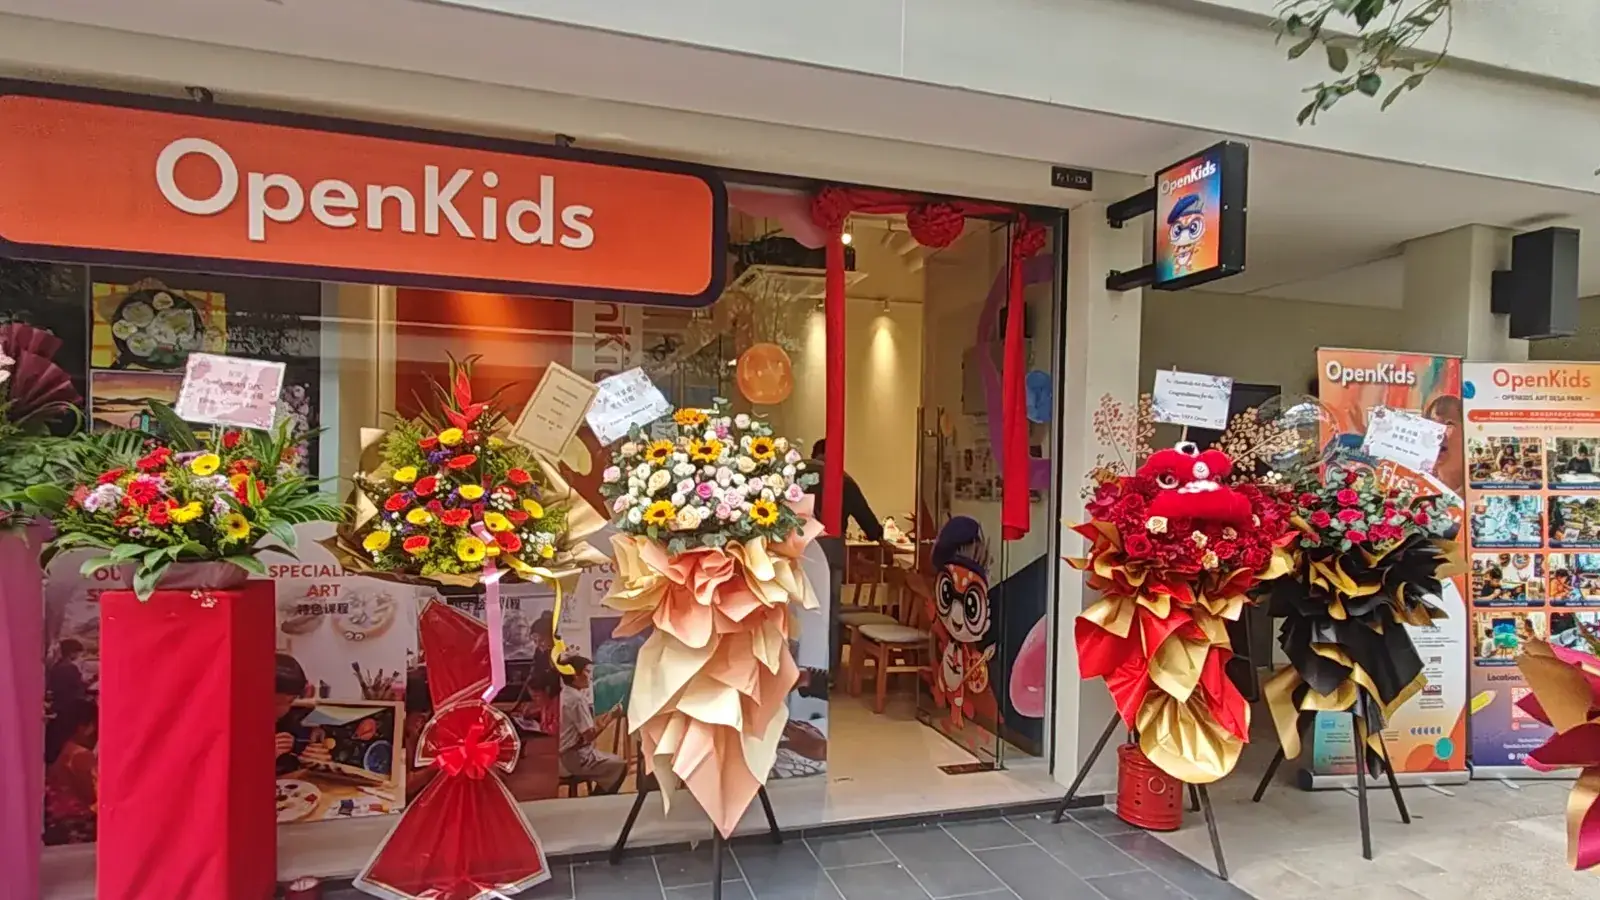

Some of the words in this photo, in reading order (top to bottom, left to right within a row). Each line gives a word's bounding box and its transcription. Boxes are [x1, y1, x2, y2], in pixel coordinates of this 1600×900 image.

[1160, 161, 1216, 196] OpenKids
[155, 137, 595, 250] OpenKids
[1325, 360, 1416, 386] OpenKids
[1493, 368, 1592, 392] OpenKids
[306, 584, 341, 598] ART
[296, 602, 349, 616] 特色课程
[1487, 673, 1522, 681] Location:
